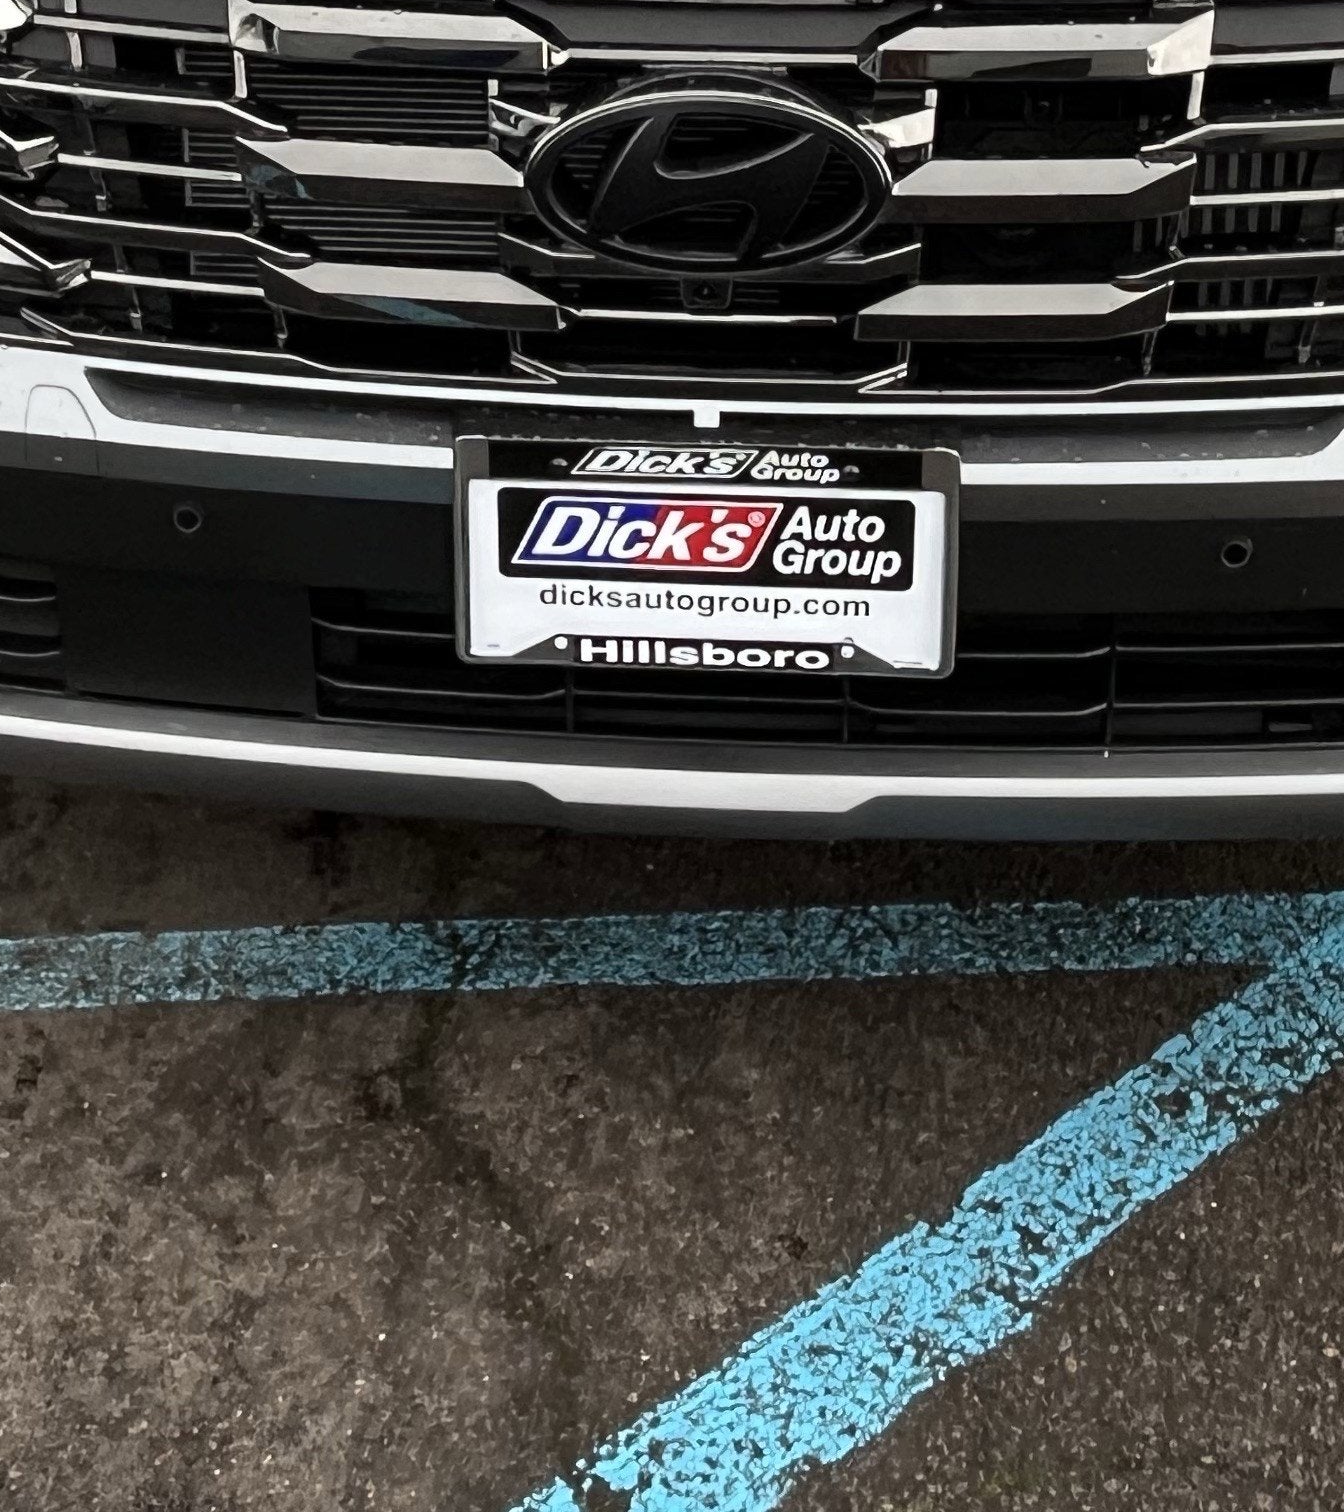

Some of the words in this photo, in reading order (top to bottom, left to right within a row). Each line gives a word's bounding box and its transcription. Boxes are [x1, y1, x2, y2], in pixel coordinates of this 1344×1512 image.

[584, 449, 738, 475] Dick's
[751, 463, 841, 484] Group
[762, 450, 830, 468] Auto
[532, 505, 752, 563] Dick's
[781, 506, 886, 543] Auto
[771, 539, 902, 584] Group
[539, 584, 871, 618] dicksautogroup.com
[579, 638, 830, 670] Hillsboro
